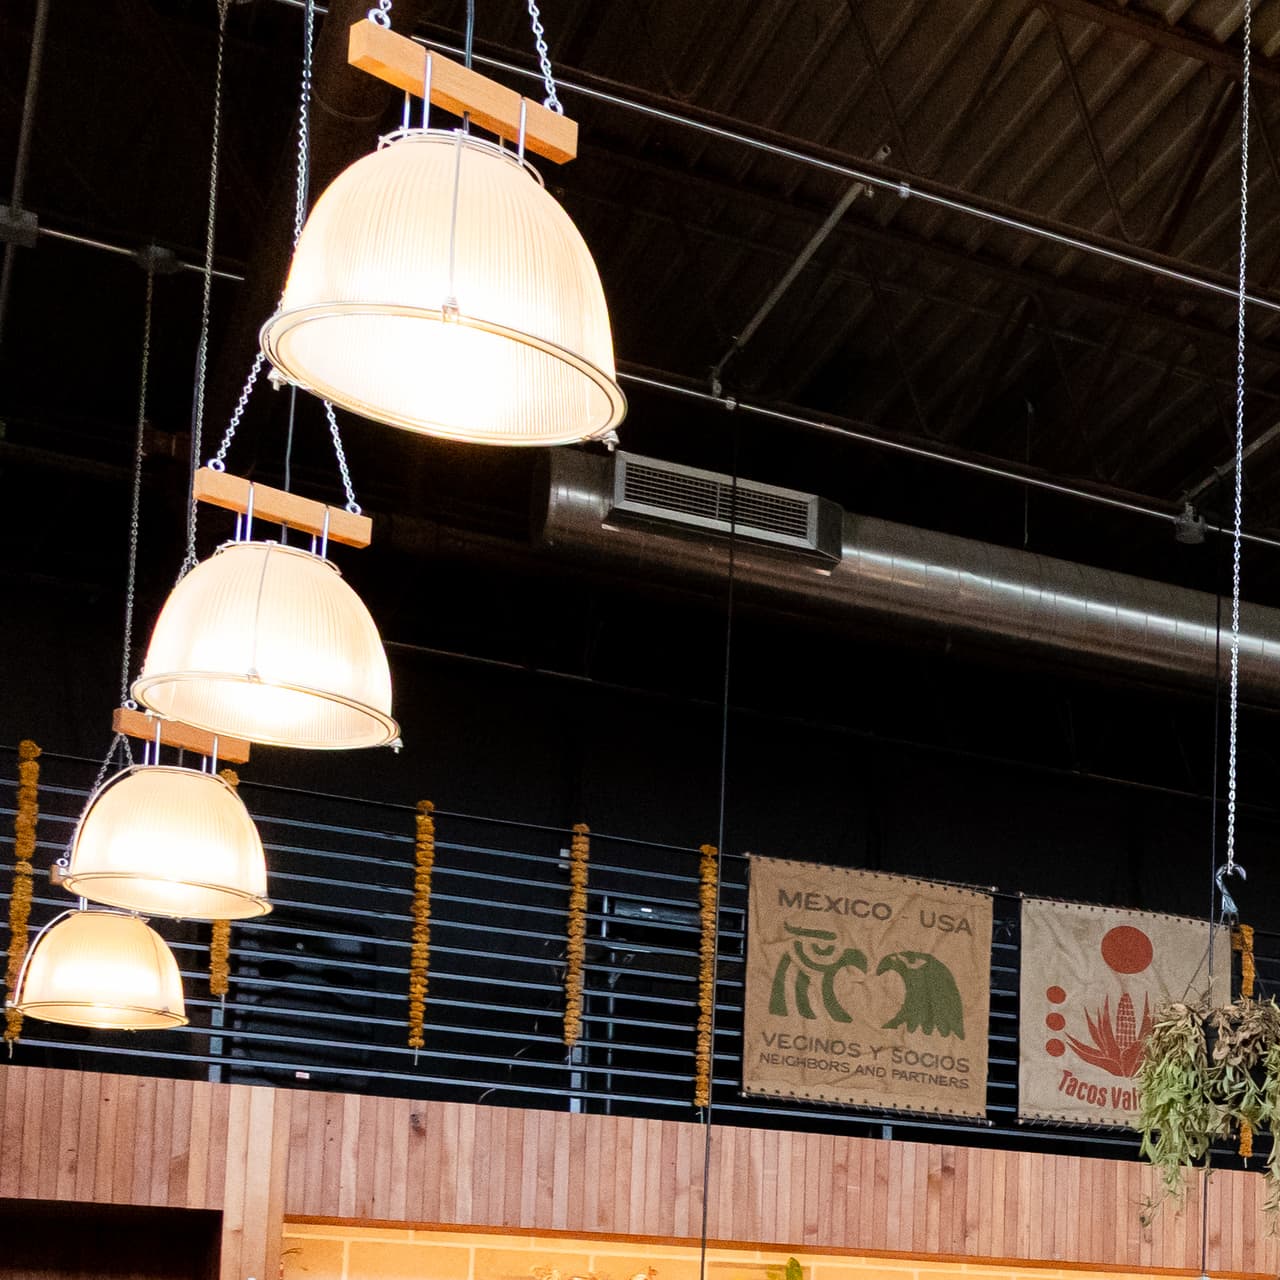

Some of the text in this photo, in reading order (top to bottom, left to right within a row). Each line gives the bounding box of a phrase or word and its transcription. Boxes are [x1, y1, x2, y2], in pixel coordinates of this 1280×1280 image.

[778, 888, 893, 921] MEXICO
[919, 909, 973, 936] USA
[759, 1052, 969, 1089] NEIGHBORS AND PARTNERS
[761, 1031, 970, 1073] VECINOS Y SOCIOS
[1058, 1069, 1143, 1111] Tacos Val
